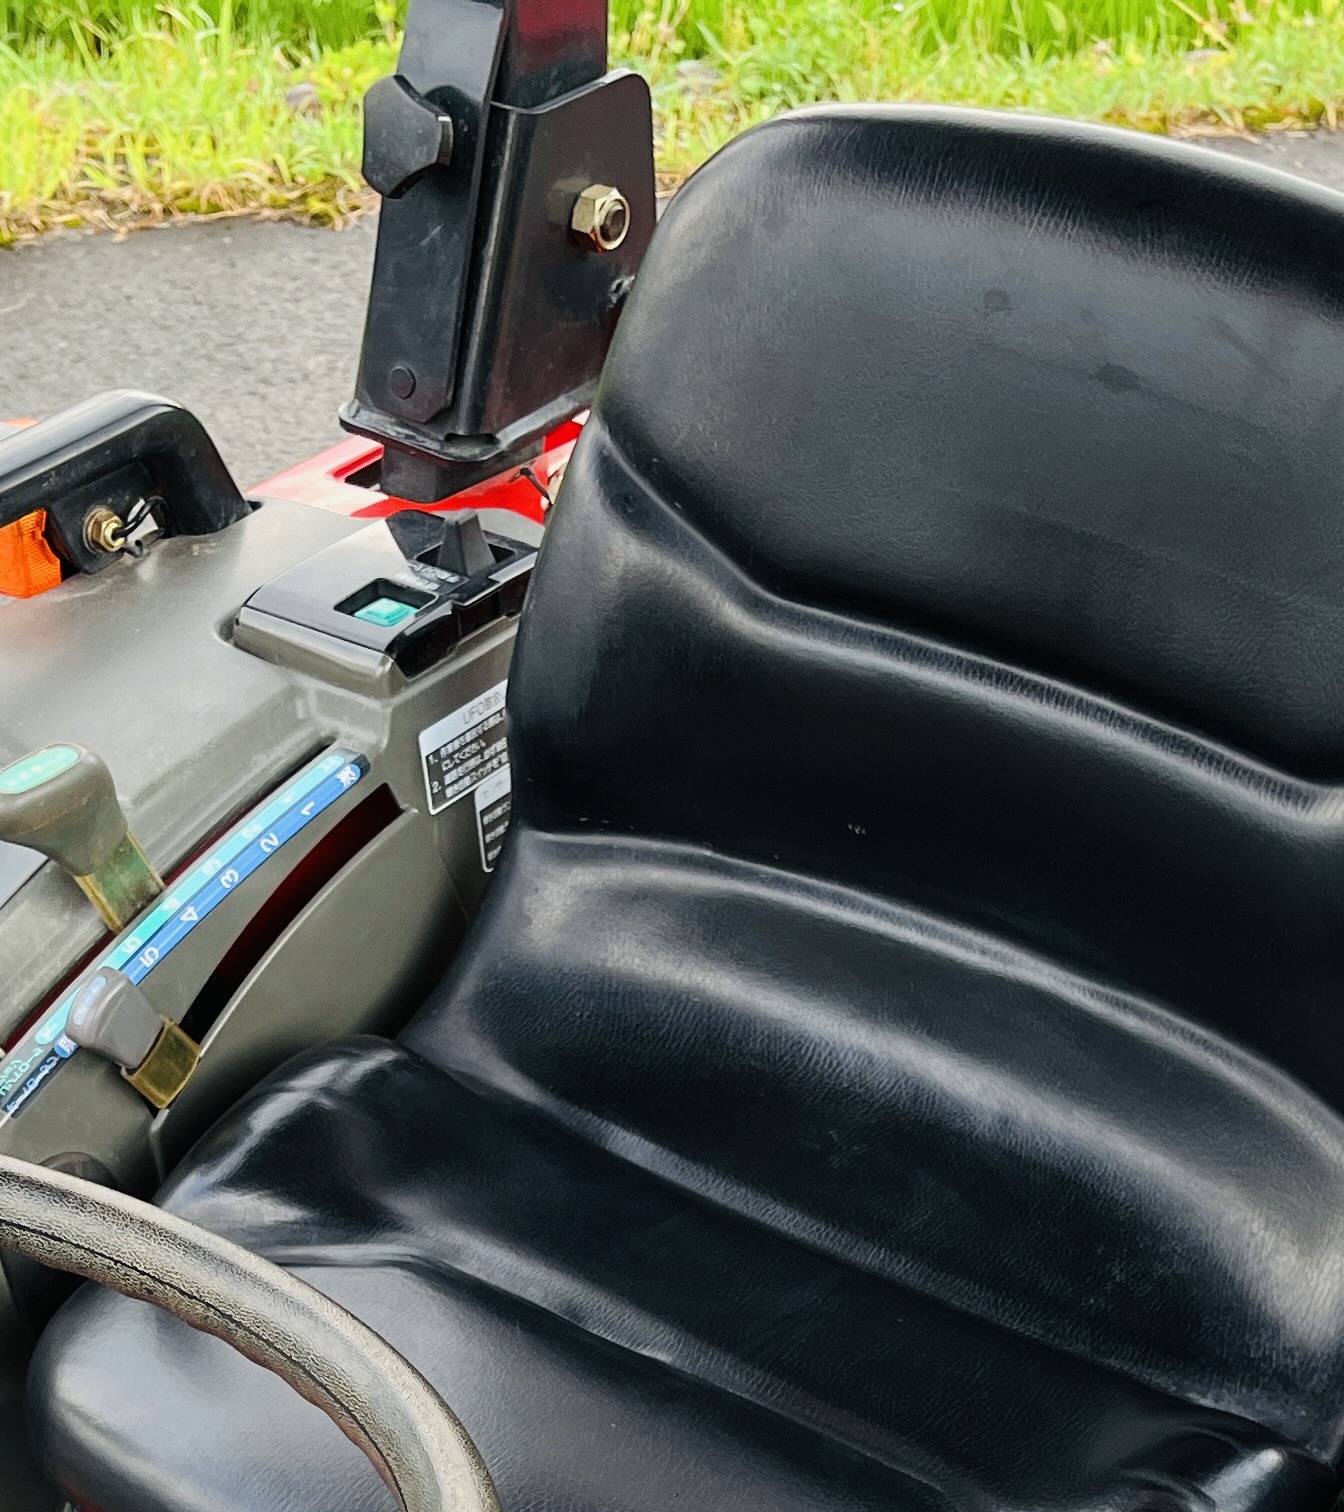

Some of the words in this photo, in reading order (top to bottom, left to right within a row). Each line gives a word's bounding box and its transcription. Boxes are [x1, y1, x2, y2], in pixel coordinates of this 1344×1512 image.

[299, 799, 318, 818] 1
[257, 830, 281, 854] 2
[218, 866, 241, 889] 3
[161, 895, 180, 915] 4
[178, 903, 202, 927] 4
[121, 934, 142, 955] 5
[137, 943, 162, 968] 5
